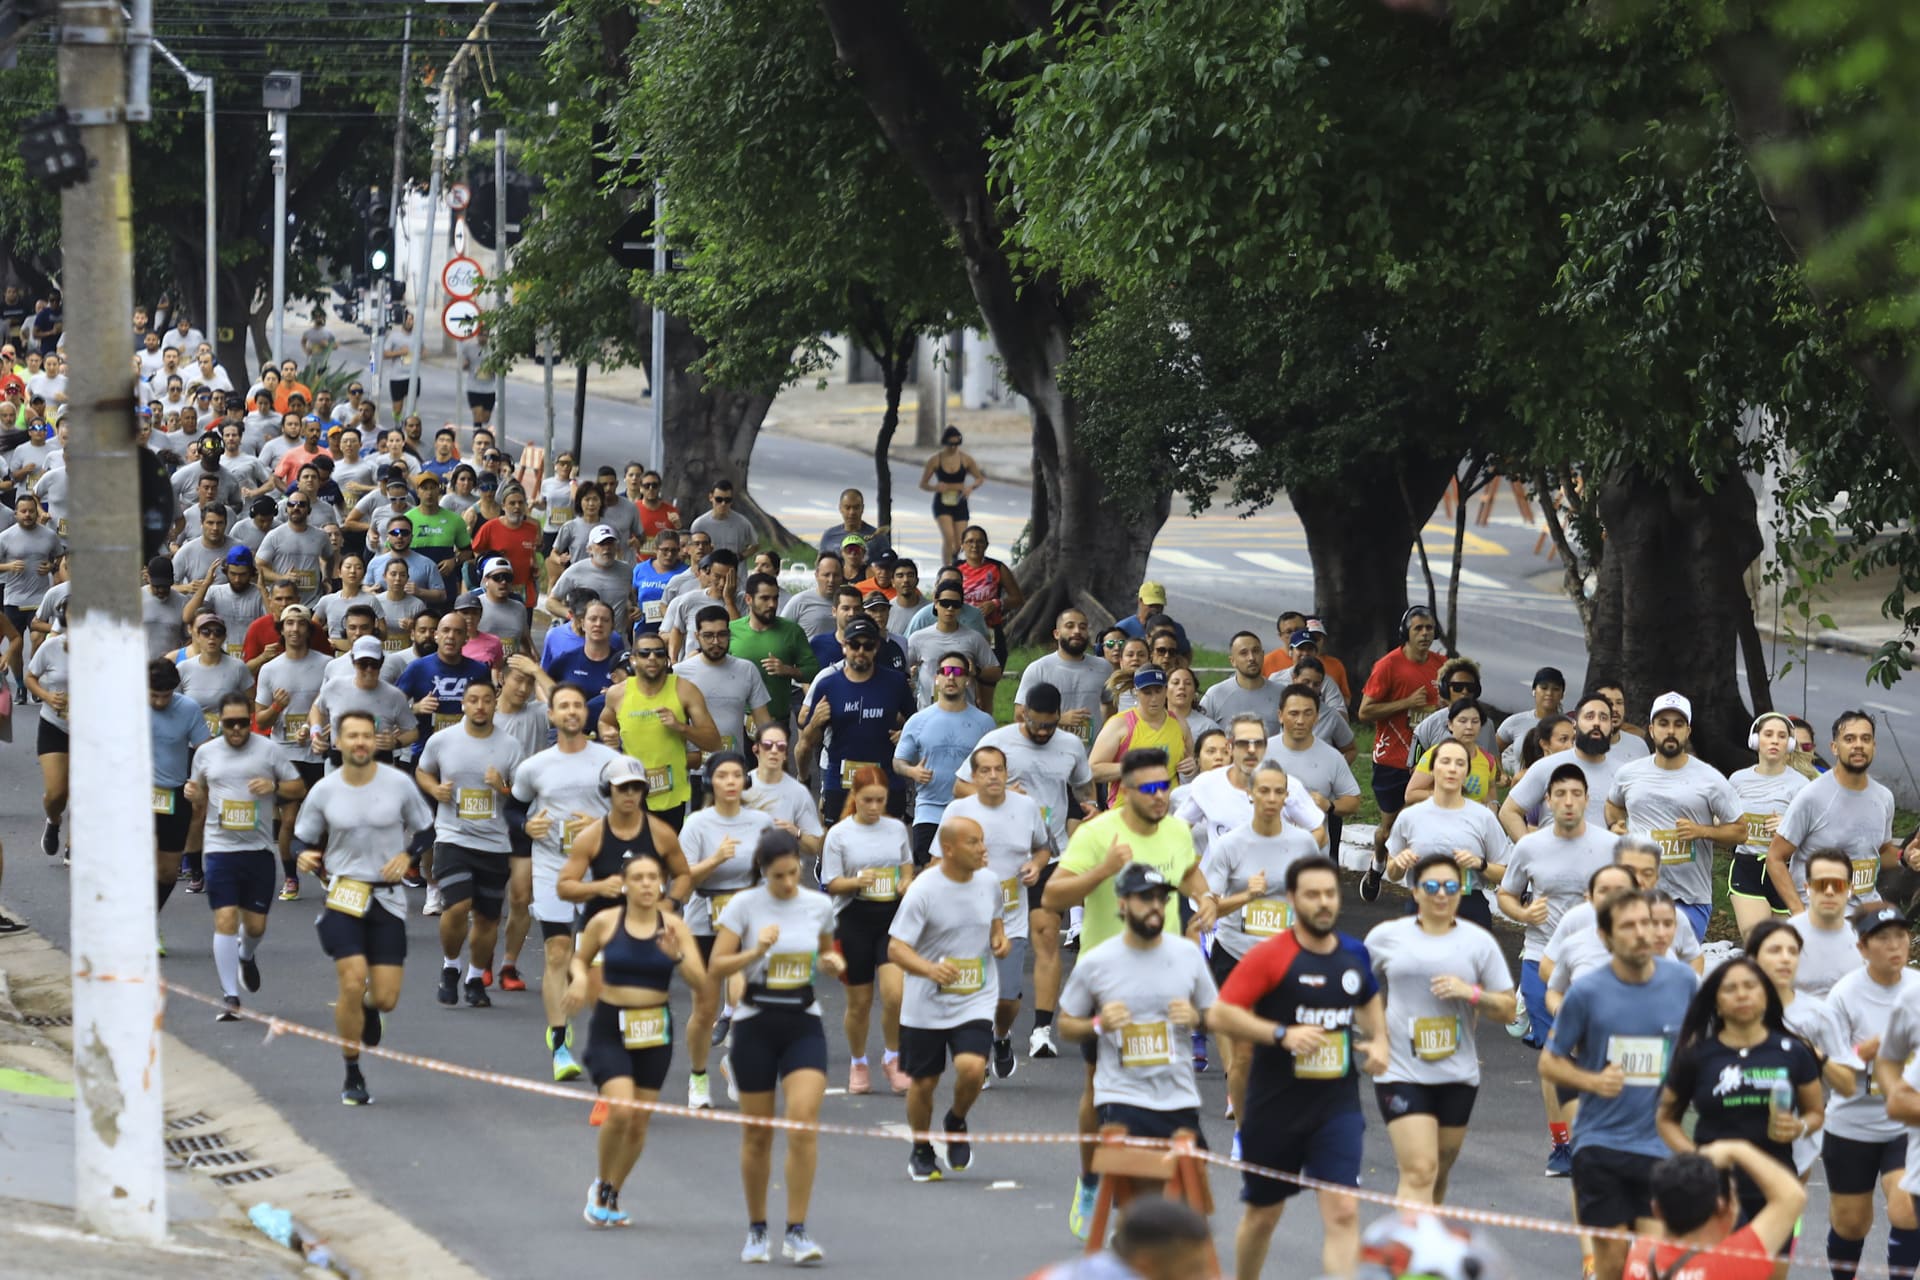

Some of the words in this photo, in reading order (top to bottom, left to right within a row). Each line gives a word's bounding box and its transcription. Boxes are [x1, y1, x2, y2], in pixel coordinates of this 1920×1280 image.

[863, 707, 883, 719] RUN
[647, 775, 664, 790] 818
[1656, 839, 1687, 855] 5747
[957, 969, 978, 985] 323
